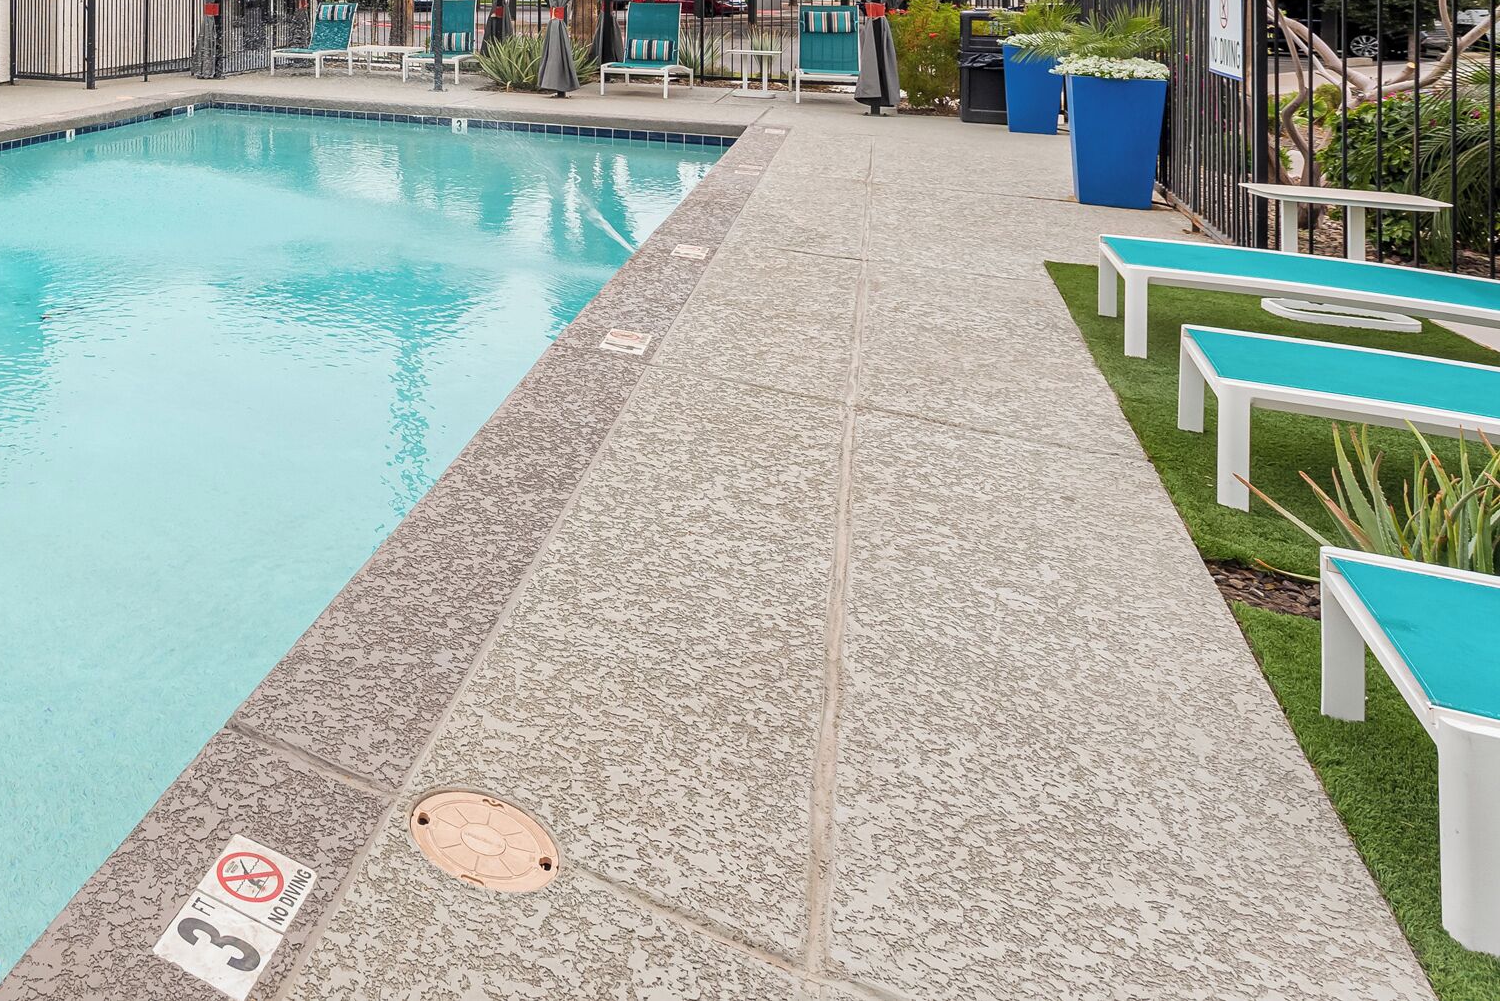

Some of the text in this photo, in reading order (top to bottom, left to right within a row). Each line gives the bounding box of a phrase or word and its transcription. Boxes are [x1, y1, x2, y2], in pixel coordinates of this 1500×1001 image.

[1220, 38, 1241, 70] DIVING
[456, 120, 462, 132] 3
[191, 896, 216, 917] FT
[267, 868, 312, 926] NO DIVING
[177, 917, 261, 972] 3
